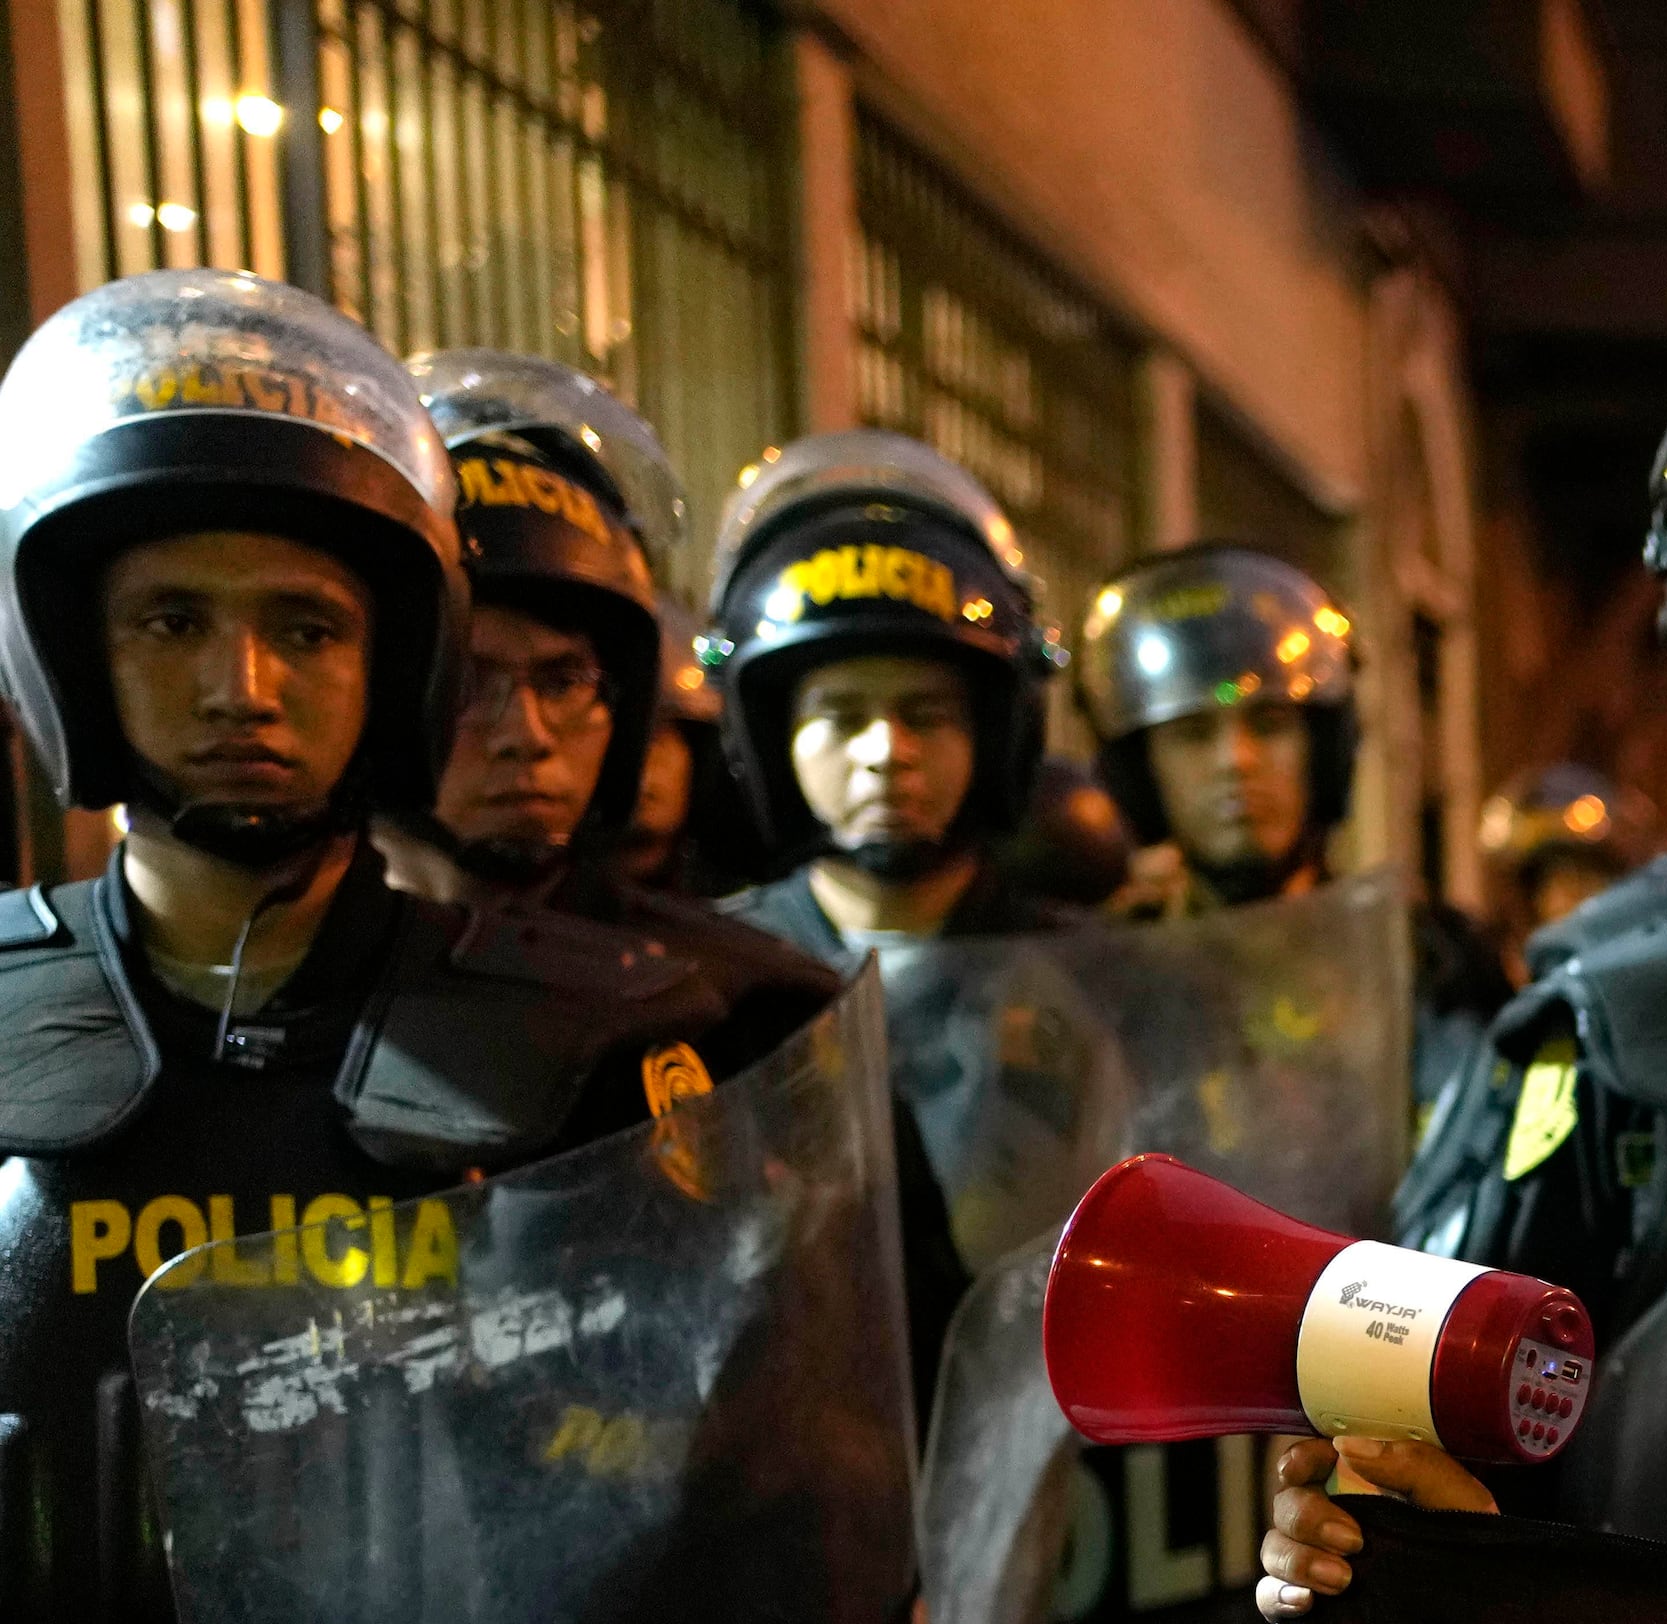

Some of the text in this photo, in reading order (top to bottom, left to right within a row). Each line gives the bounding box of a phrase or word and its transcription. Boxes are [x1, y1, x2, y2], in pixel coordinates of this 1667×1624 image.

[70, 1193, 458, 1294] POLICIA
[1366, 1321, 1383, 1339] 40
[1387, 1322, 1409, 1336] Watts
[1384, 1333, 1404, 1345] Peak
